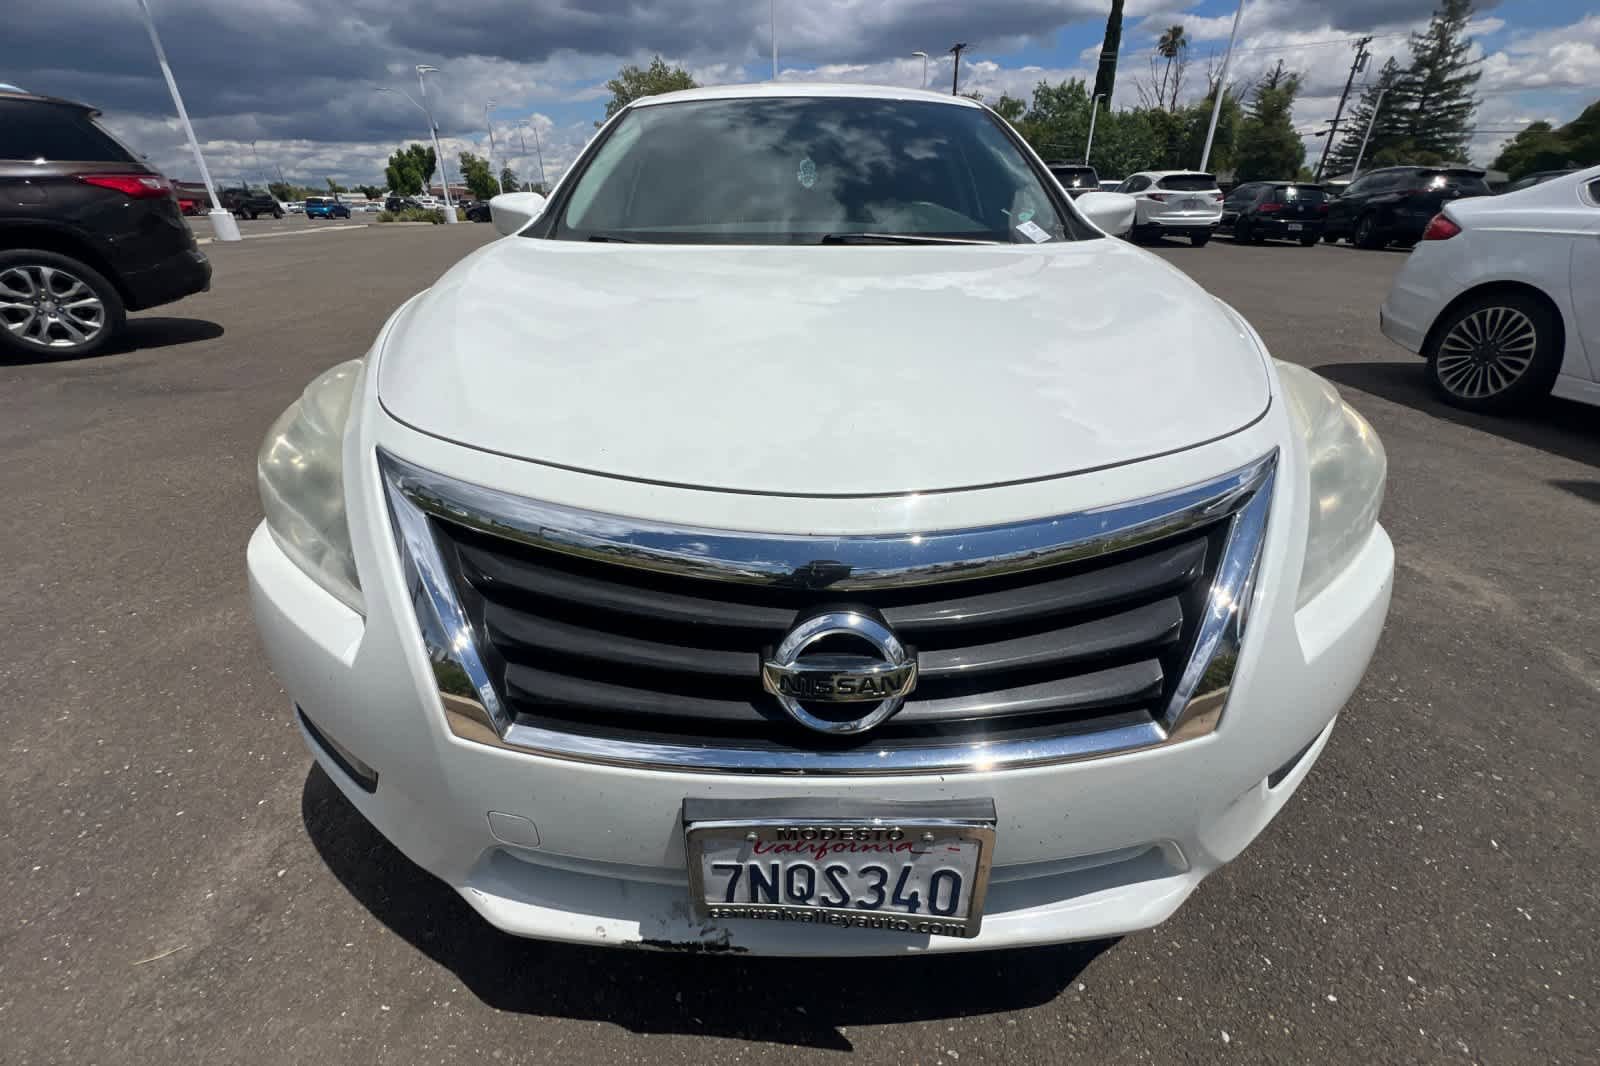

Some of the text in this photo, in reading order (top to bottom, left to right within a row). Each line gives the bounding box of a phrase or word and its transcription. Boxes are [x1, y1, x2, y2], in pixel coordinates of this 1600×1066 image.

[780, 674, 900, 696] NISSAN
[776, 827, 905, 842] MODESTO
[752, 838, 914, 861] California
[712, 862, 963, 916] 7NQS340
[709, 907, 967, 936] centralvalleyauto.com
